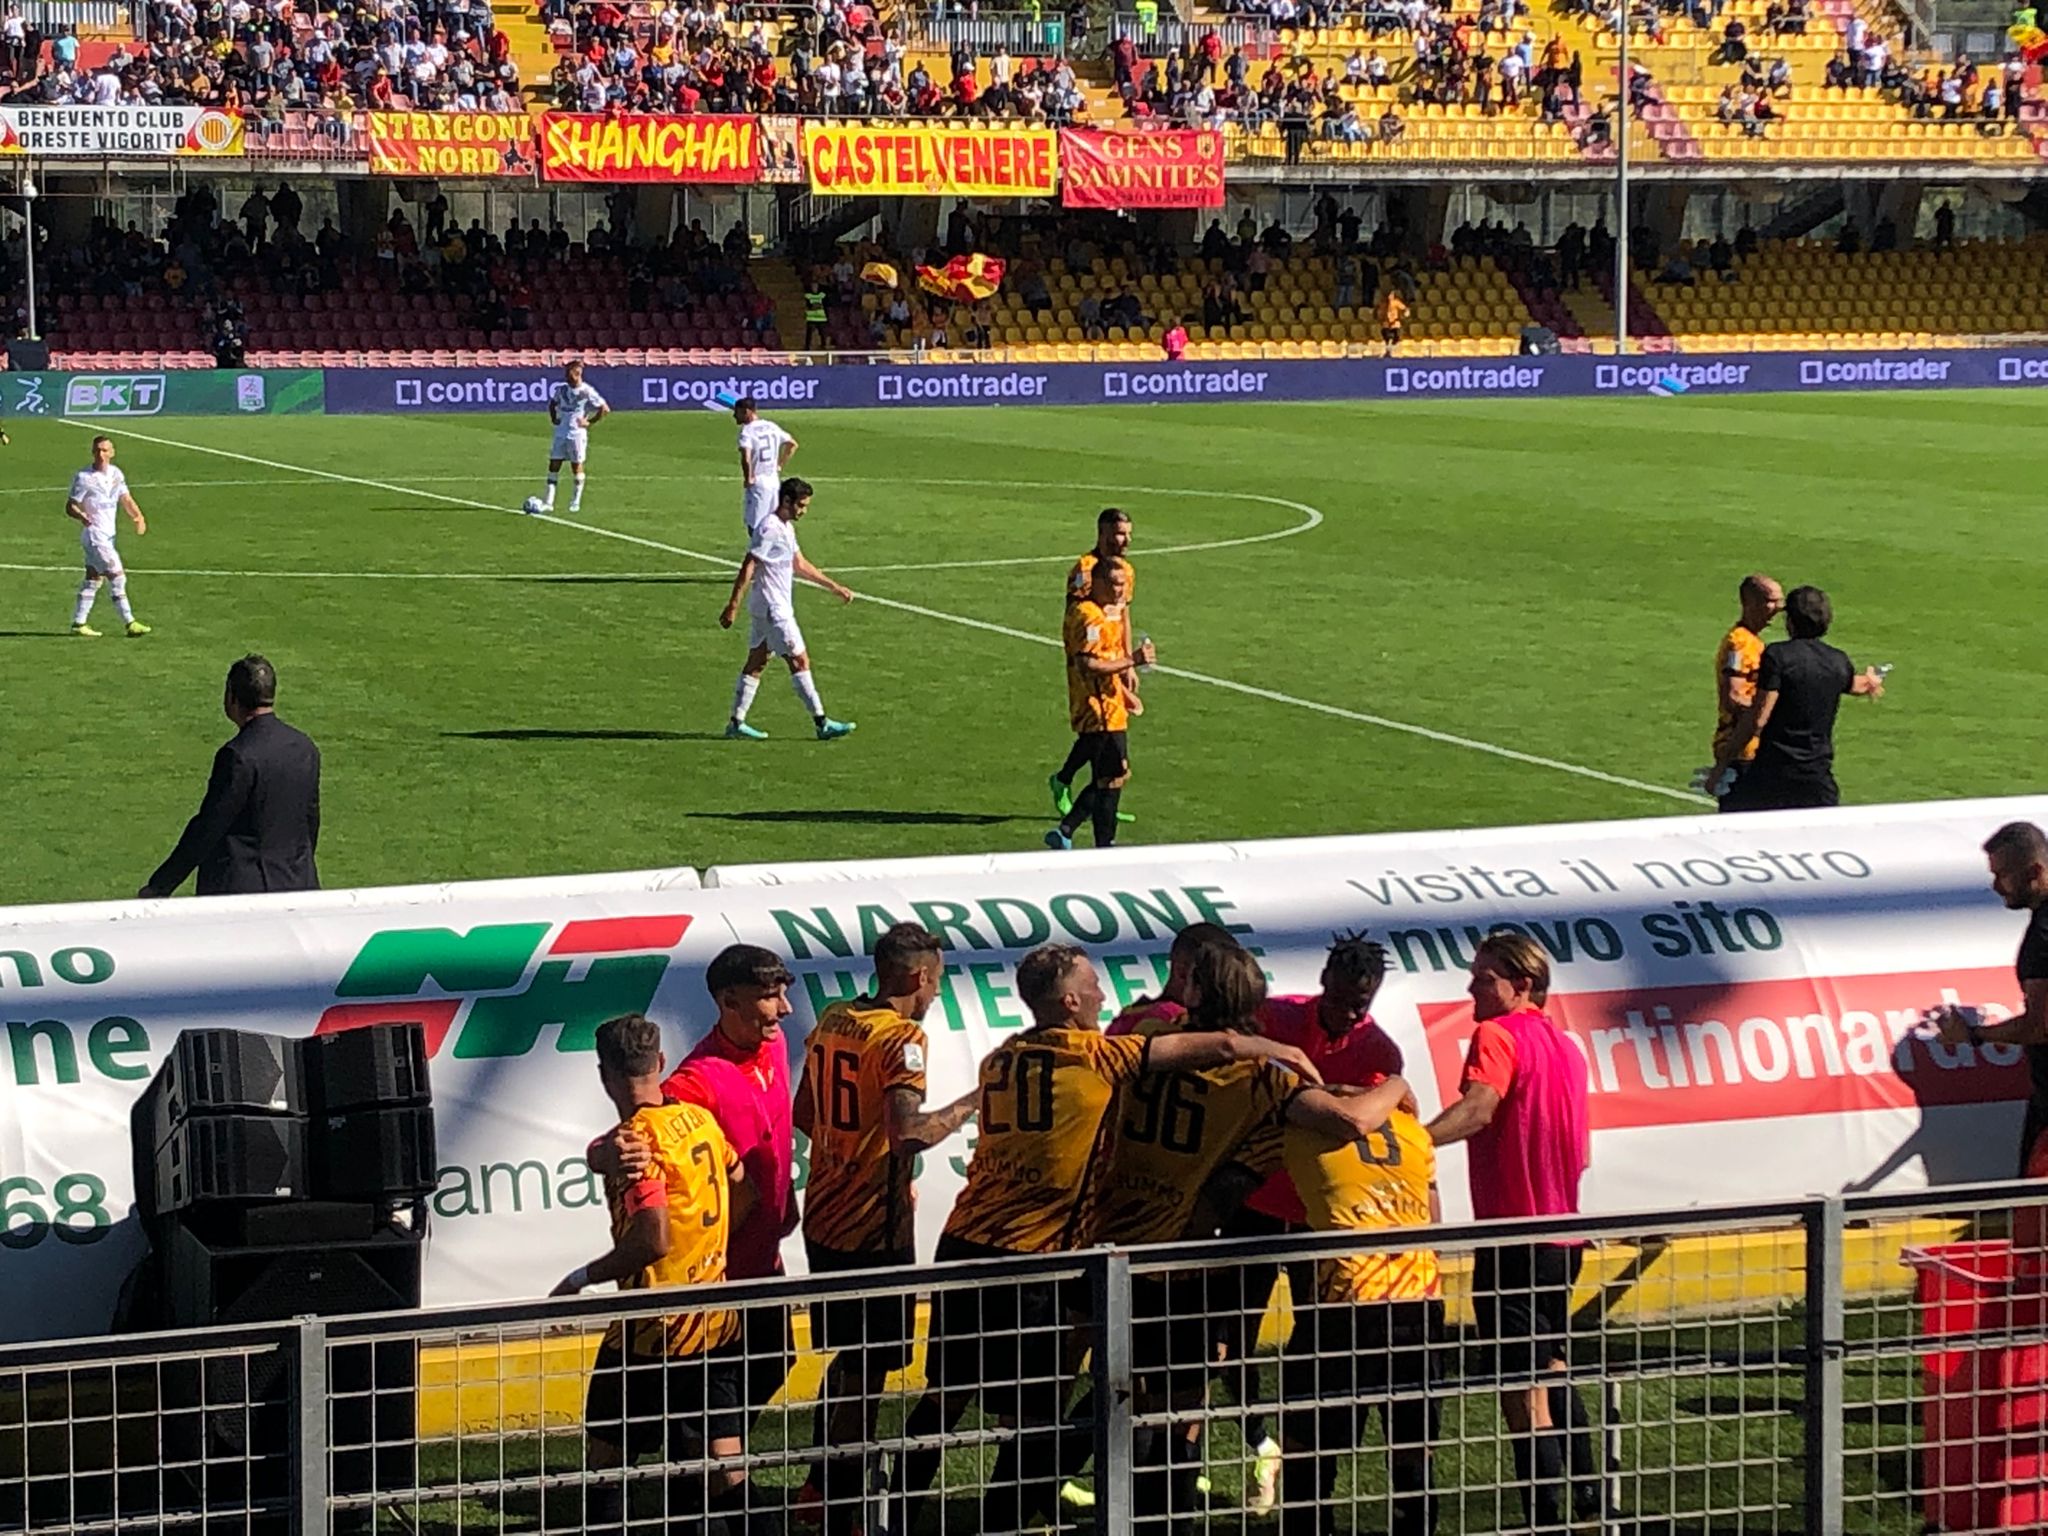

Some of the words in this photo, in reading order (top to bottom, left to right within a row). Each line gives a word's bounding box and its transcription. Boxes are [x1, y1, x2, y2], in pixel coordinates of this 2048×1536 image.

[17, 111, 129, 127] BENEVENTO
[136, 111, 184, 128] CLUB
[371, 112, 531, 142] STREGONI
[19, 131, 91, 148] ORESTE
[97, 132, 186, 149] VIGORITO
[547, 119, 752, 176] SHANGHAI
[1102, 135, 1183, 159] GENS
[417, 146, 500, 174] NORD
[813, 135, 1051, 188] CASTELVENERE
[1068, 163, 1220, 188] SAMNITES
[1131, 370, 1269, 394] contrader
[1411, 366, 1544, 389] contrader
[1621, 362, 1751, 387] contrader
[1825, 358, 1951, 382] contrader
[69, 384, 158, 405] BKT
[426, 379, 562, 402] contrade
[672, 376, 819, 400] contrader
[906, 373, 1047, 398] contrader
[757, 433, 779, 463] 21
[1346, 868, 1556, 907] visita
[1560, 859, 1619, 892] il
[1632, 849, 1873, 892] nostro
[769, 886, 1255, 960] NARDONE
[1641, 900, 1786, 958] sito
[813, 1043, 865, 1132] 16
[983, 1049, 1055, 1136] 20
[1124, 1071, 1209, 1154] 96
[691, 1140, 721, 1228] 3
